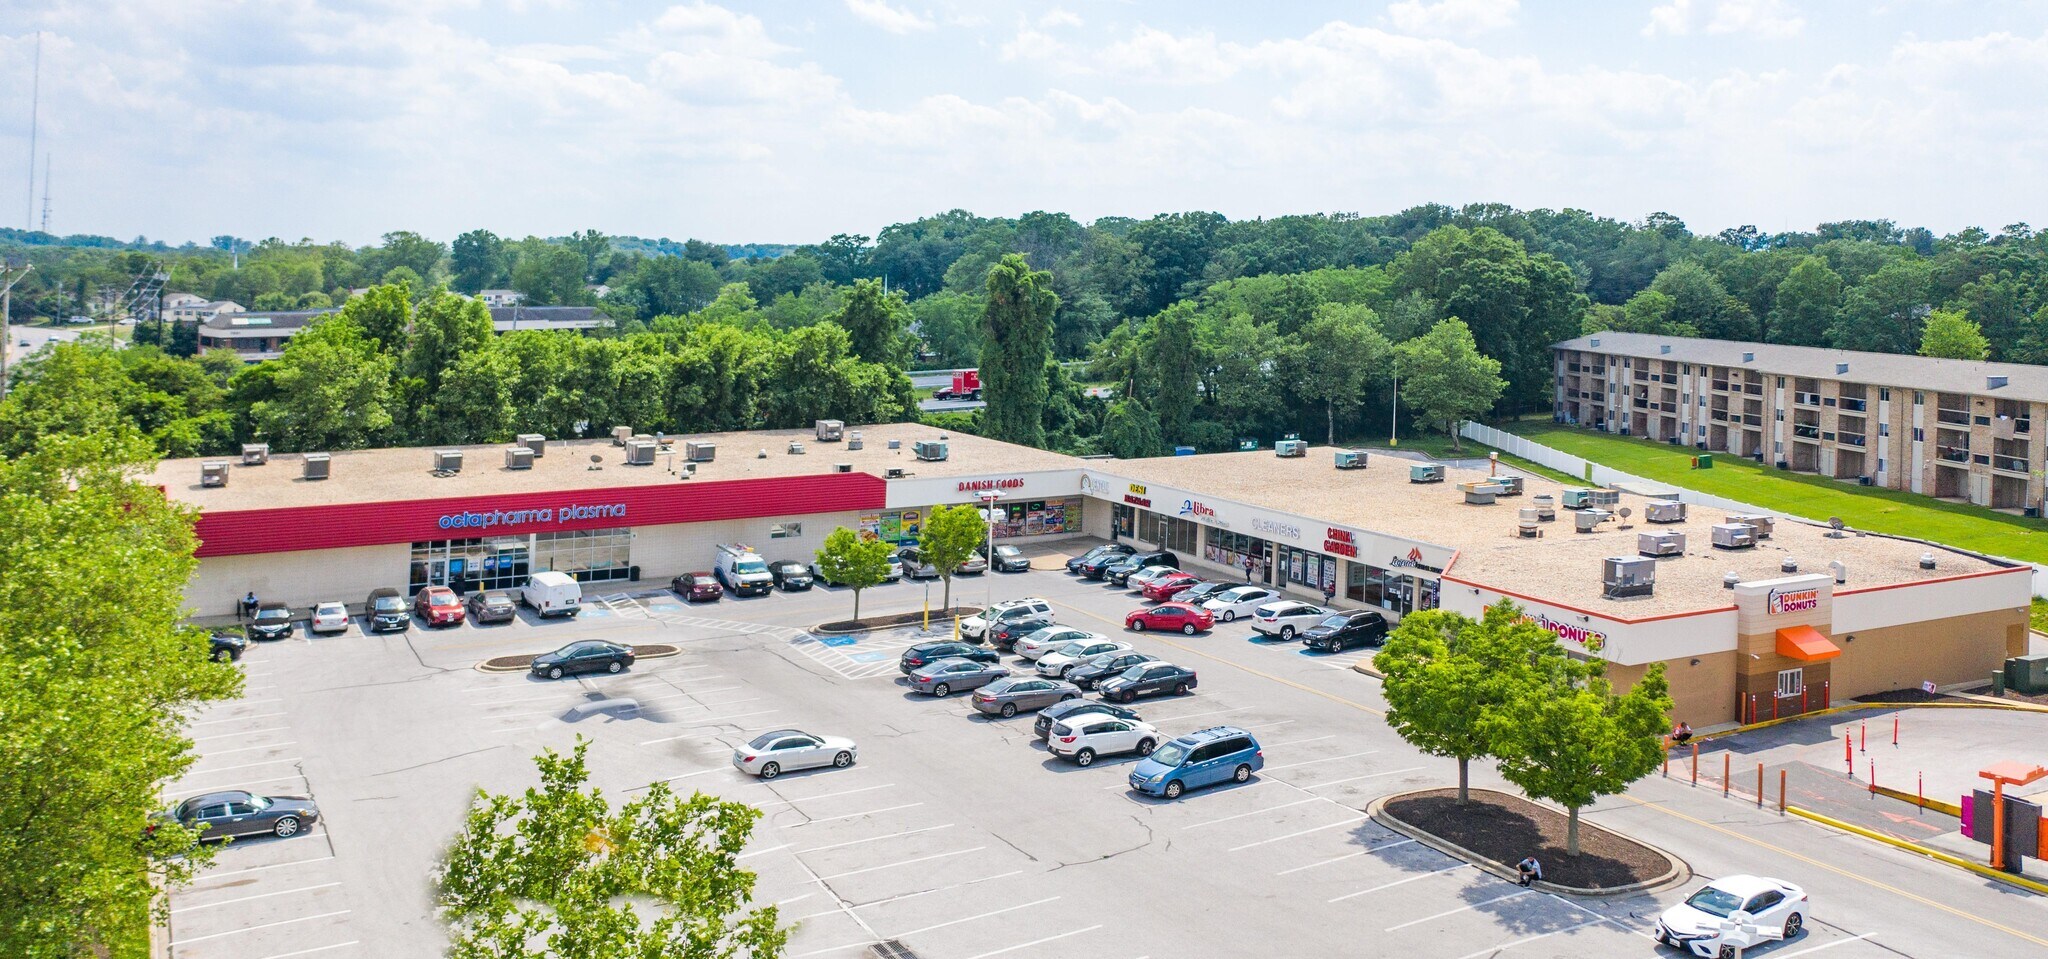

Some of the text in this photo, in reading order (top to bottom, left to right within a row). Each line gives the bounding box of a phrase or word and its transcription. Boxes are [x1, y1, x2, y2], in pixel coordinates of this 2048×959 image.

[958, 478, 1025, 491] DANISH FOODS
[439, 503, 626, 529] octapharma plasma
[1193, 501, 1214, 516] Libra
[1251, 518, 1300, 540] CLEANERS
[1327, 527, 1353, 544] CHINA
[1323, 540, 1357, 558] GARDEN
[1784, 599, 1817, 612] DONUTS
